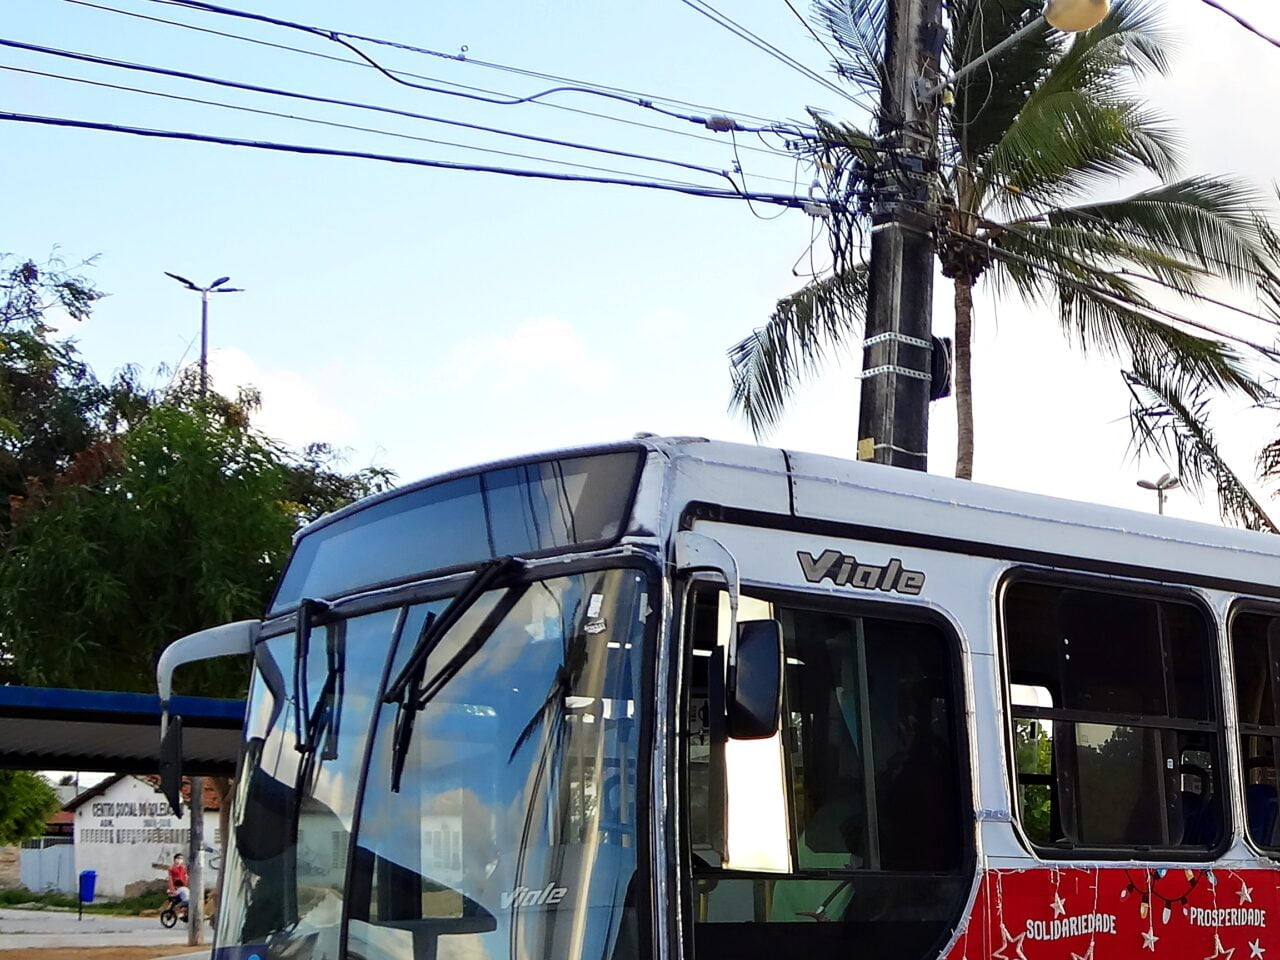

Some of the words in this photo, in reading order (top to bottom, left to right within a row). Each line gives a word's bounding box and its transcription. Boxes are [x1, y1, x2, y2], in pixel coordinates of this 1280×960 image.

[796, 549, 926, 596] Viale
[93, 802, 114, 817] CENTRO
[501, 882, 568, 909] Viale
[1026, 913, 1117, 941] SOLIDARIEDADE
[1190, 907, 1266, 928] PROSPERIDADE
